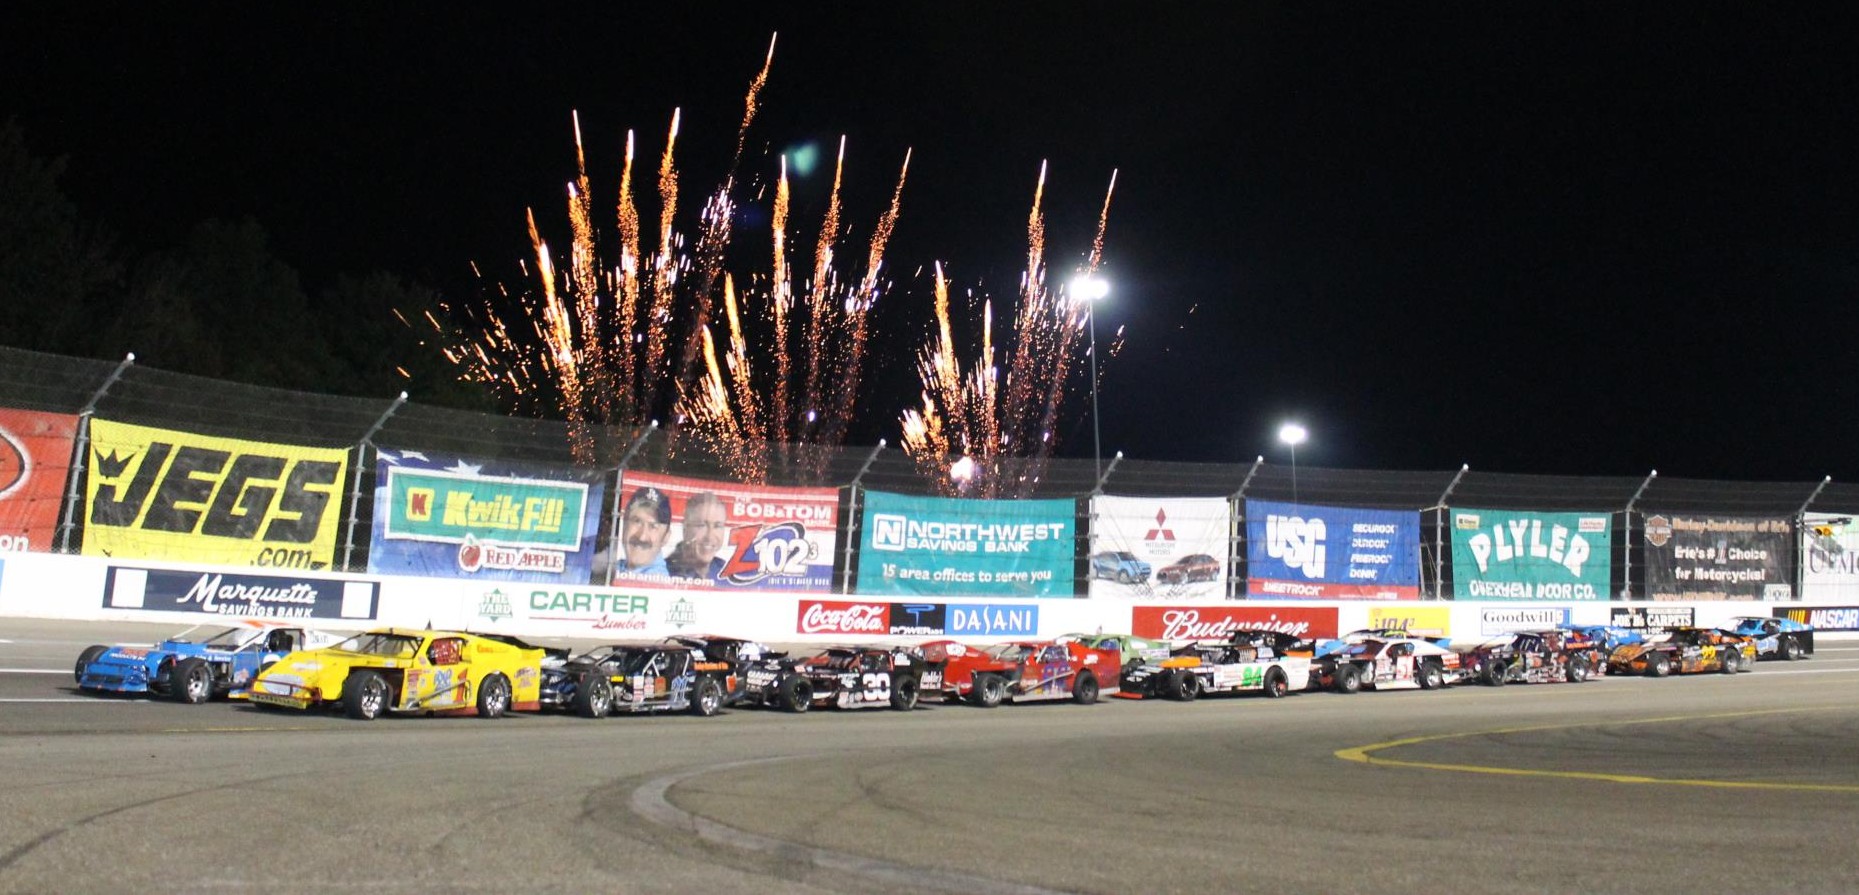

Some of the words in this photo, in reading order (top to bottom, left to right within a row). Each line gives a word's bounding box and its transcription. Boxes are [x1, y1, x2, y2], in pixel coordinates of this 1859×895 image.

[90, 441, 342, 544] JEGS
[907, 520, 1065, 541] NORTHWEST
[906, 540, 977, 552] SAVINGS
[985, 541, 1029, 552] BANK
[1266, 514, 1327, 579] USG
[1468, 518, 1590, 578] PLYLER
[1674, 545, 1706, 560] Erie's
[1728, 547, 1768, 560] Choice
[250, 547, 313, 568] .com
[882, 563, 897, 578] 15
[899, 568, 930, 581] area
[933, 567, 975, 582] offices
[978, 570, 992, 582] to
[996, 570, 1028, 582] serve
[1031, 569, 1052, 584] you
[1675, 566, 1693, 580] for
[176, 574, 319, 612] Marquette
[529, 591, 649, 614] CARTER
[218, 604, 272, 618] SAVINGS
[276, 607, 314, 618] BANK
[953, 606, 1032, 634] DASANI
[1483, 610, 1554, 624] Goodwill
[1646, 613, 1693, 627] CARPETS
[1810, 608, 1858, 629] NASCAR
[592, 614, 647, 630] Lumber
